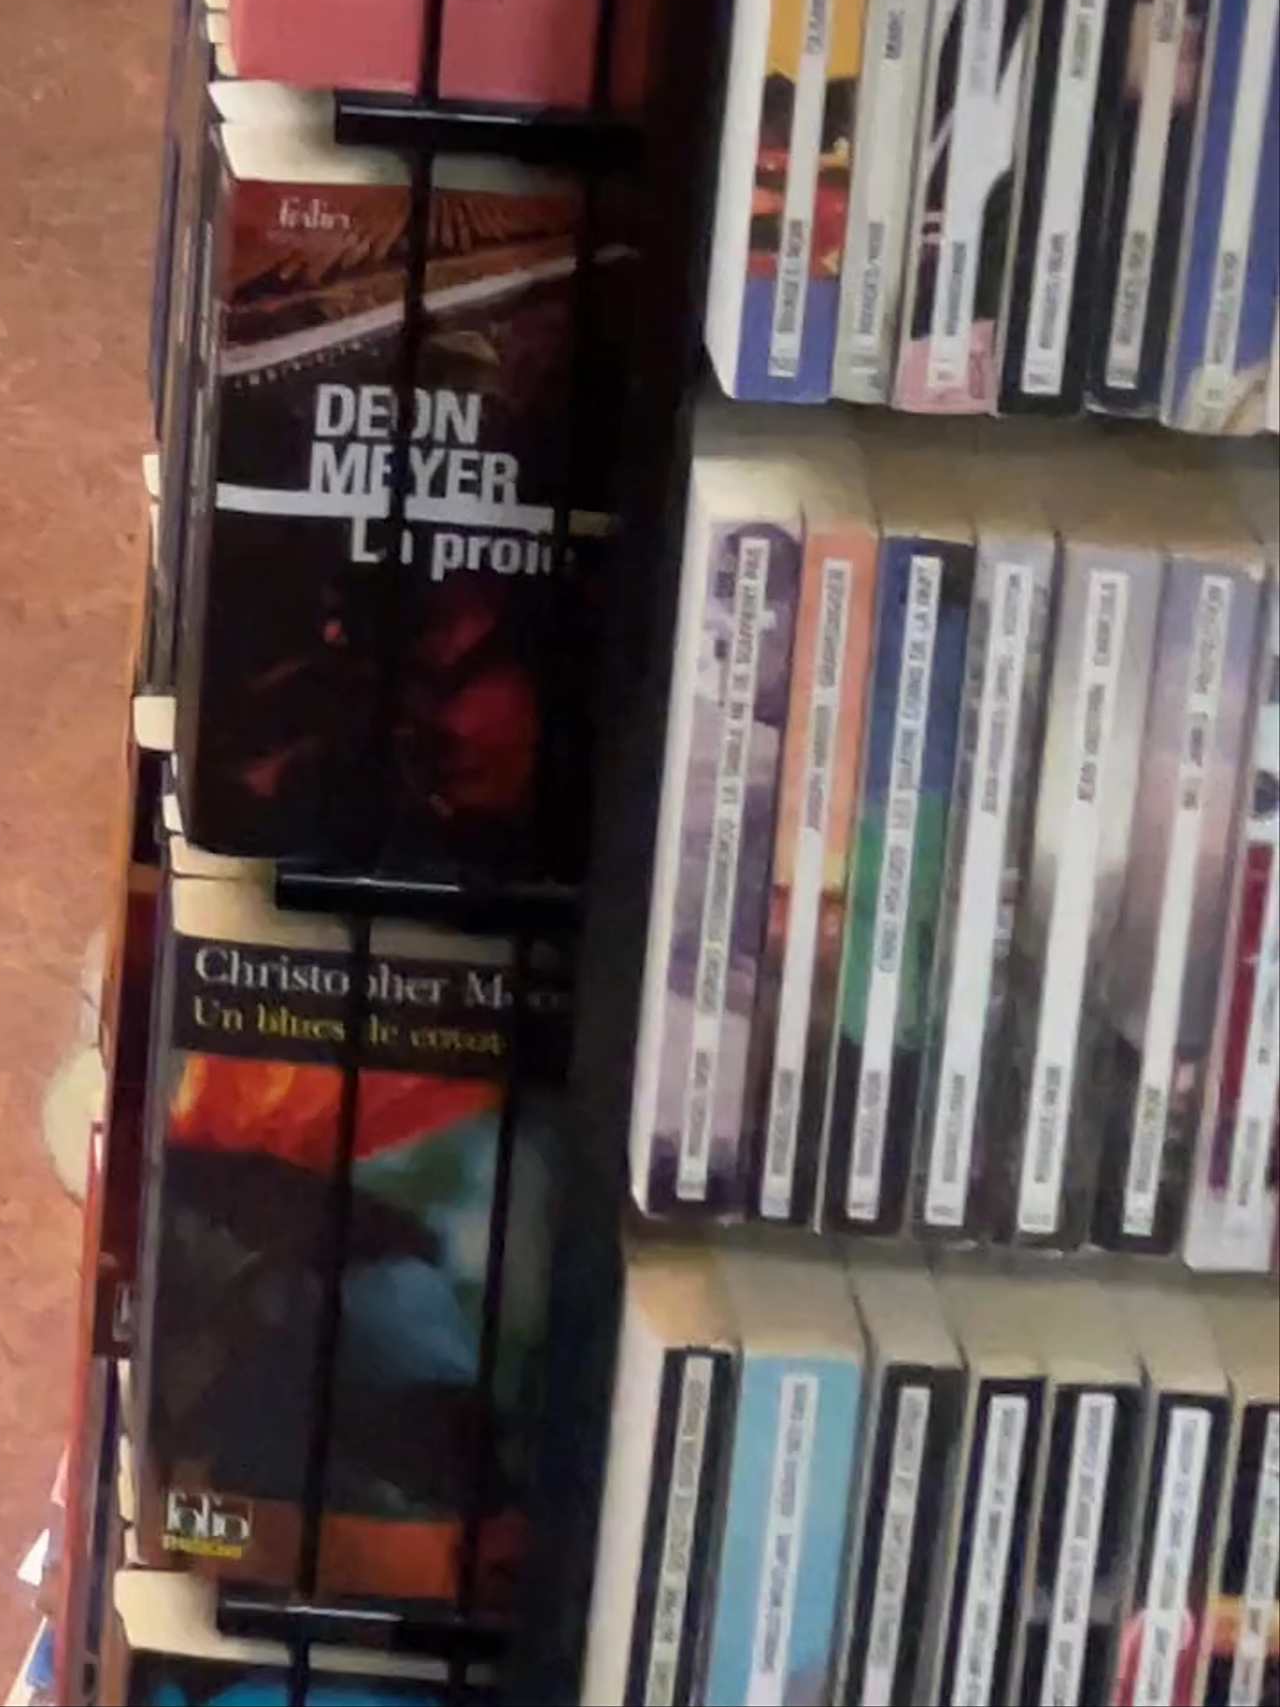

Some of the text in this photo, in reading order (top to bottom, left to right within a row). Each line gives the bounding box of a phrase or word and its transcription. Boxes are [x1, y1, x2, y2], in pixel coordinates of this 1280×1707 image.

[309, 440, 519, 508] MEYER
[194, 946, 444, 1006] Christoher
[194, 995, 243, 1032] Un
[256, 1001, 347, 1044] blues
